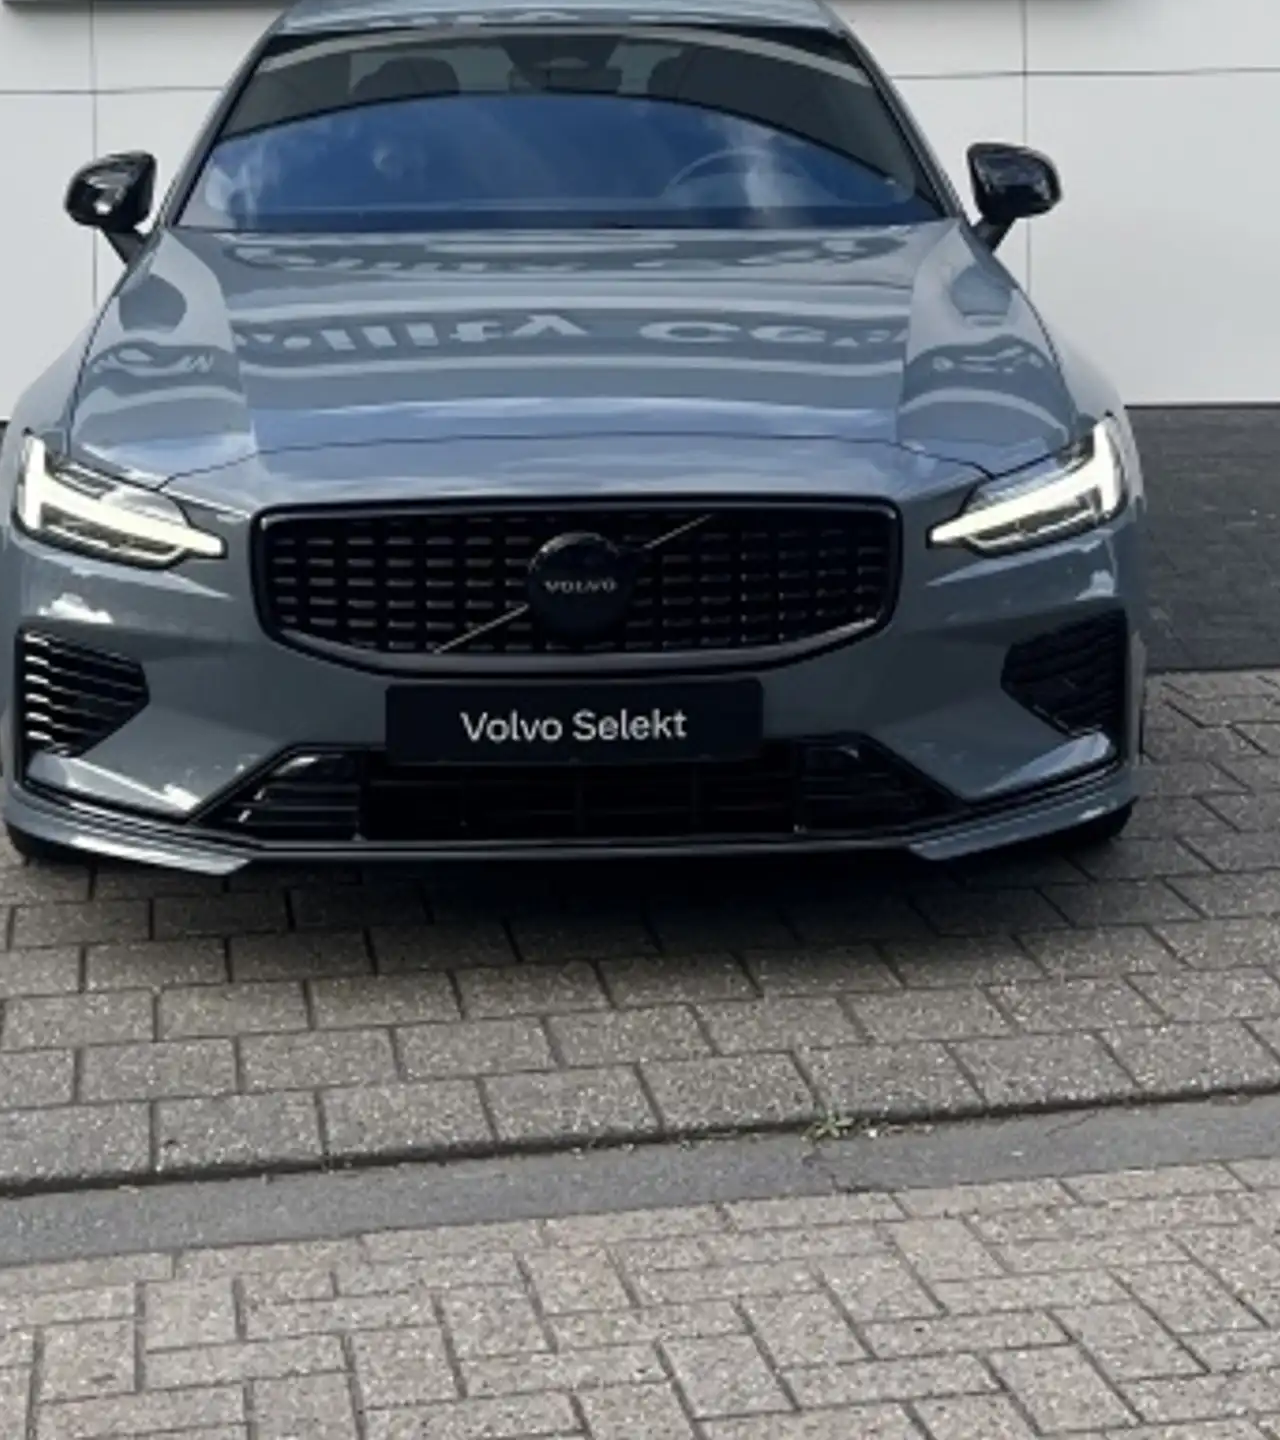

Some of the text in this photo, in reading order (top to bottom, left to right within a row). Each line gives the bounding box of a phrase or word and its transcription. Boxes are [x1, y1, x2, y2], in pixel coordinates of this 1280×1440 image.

[544, 578, 618, 594] VOLVO
[460, 708, 688, 743] Volvo Selekt
